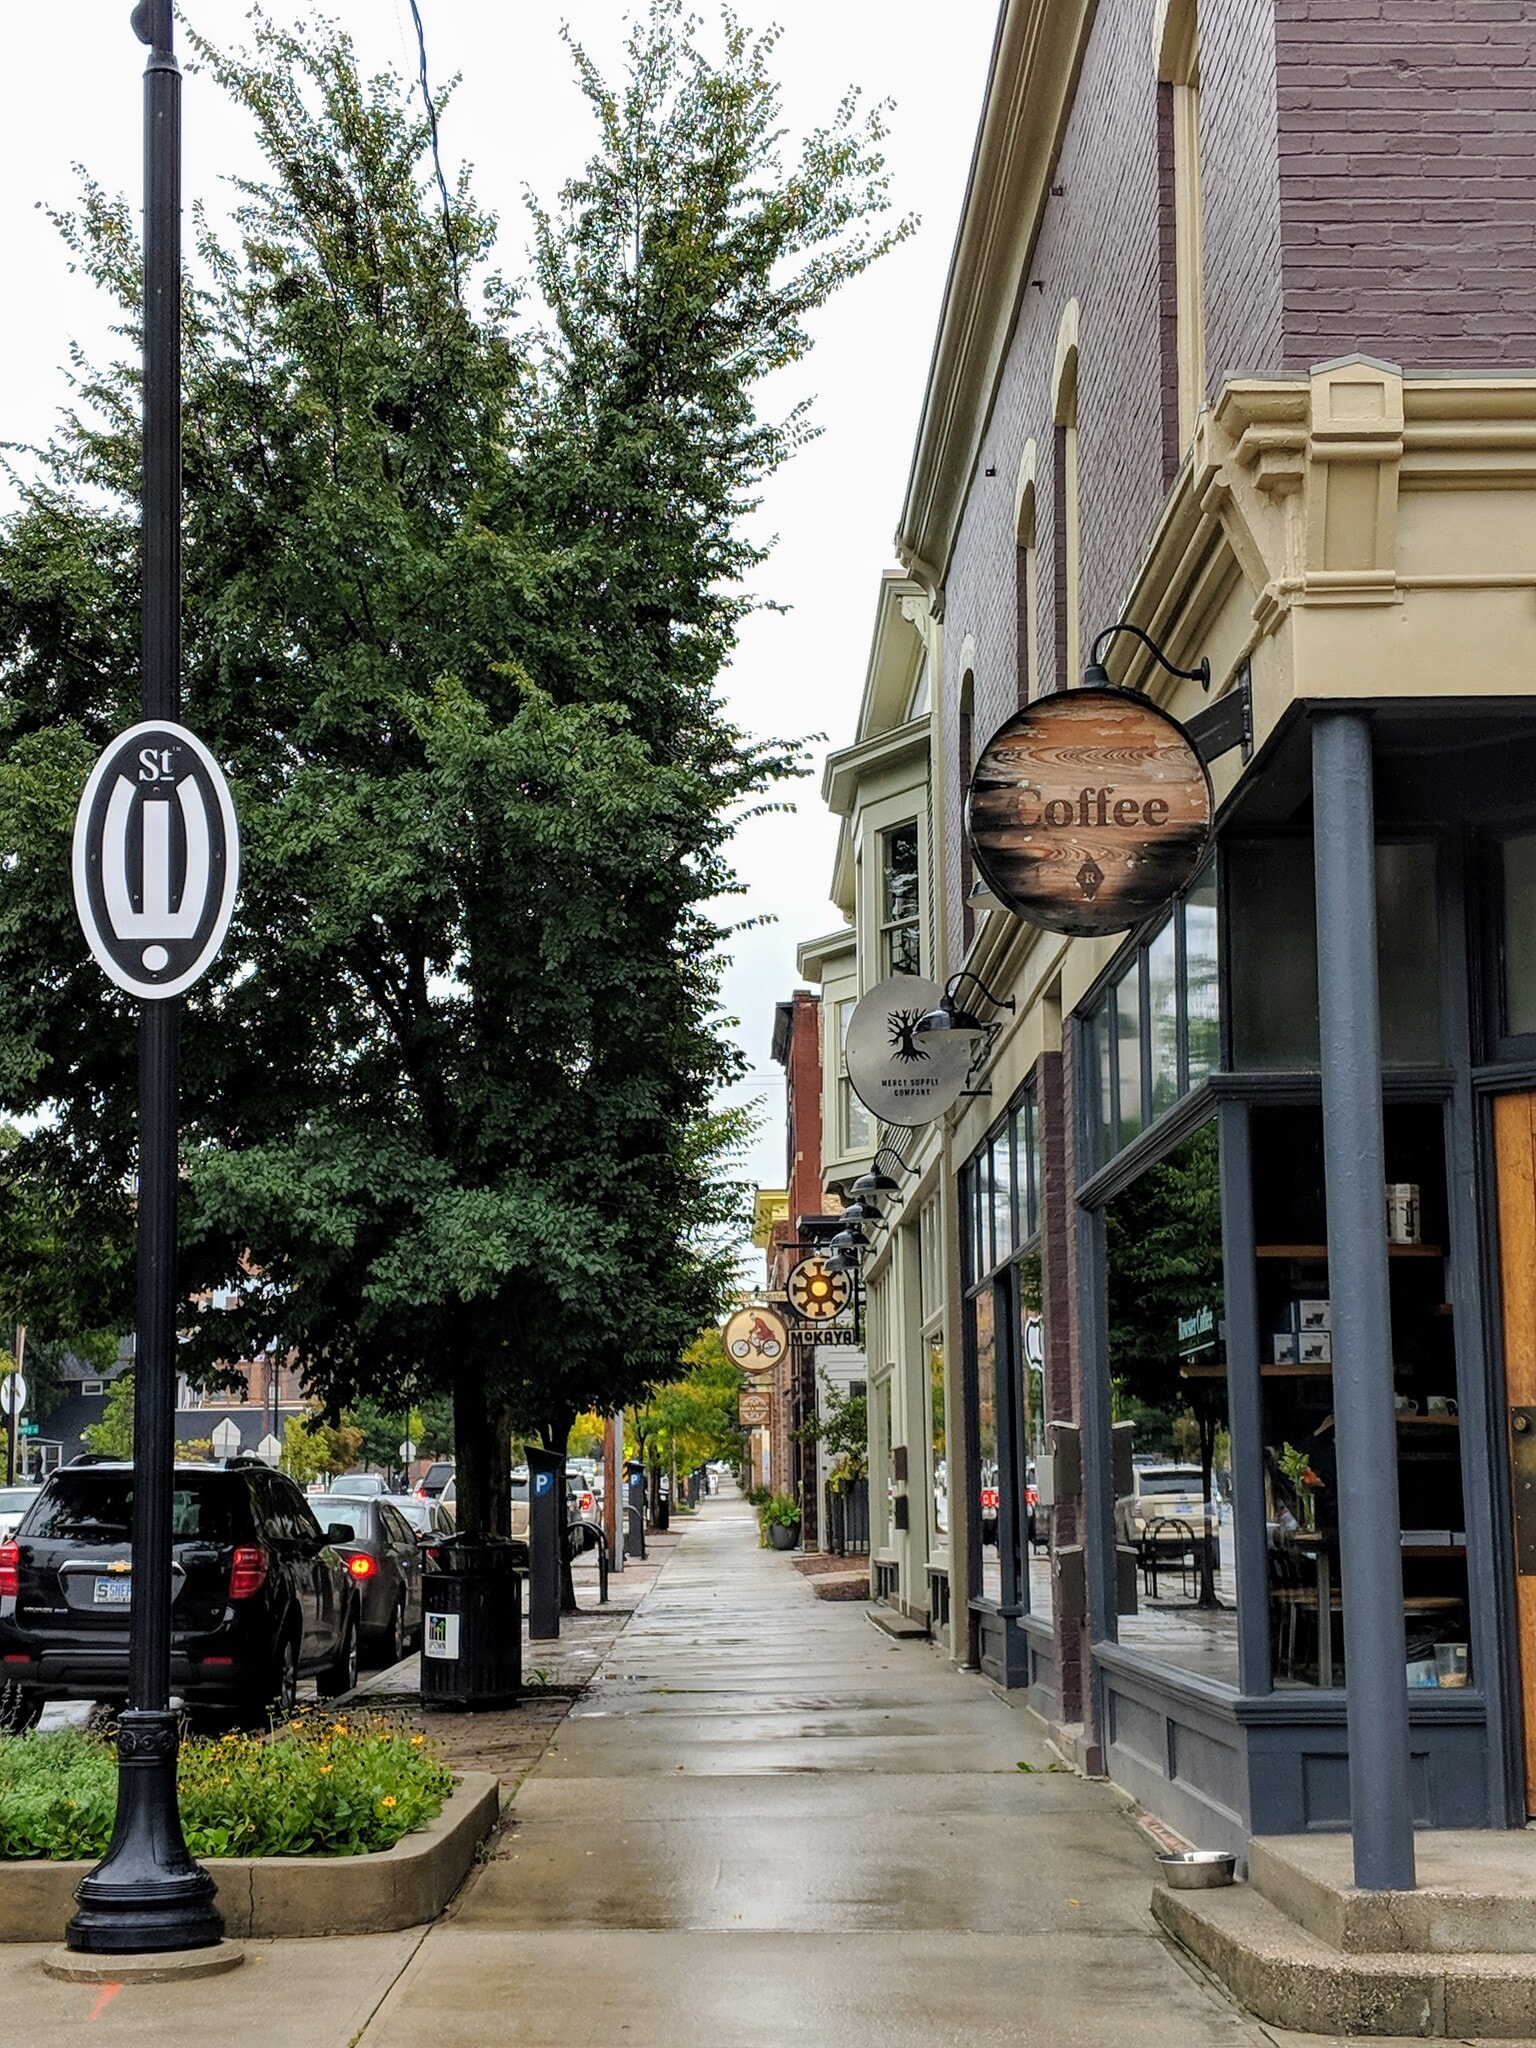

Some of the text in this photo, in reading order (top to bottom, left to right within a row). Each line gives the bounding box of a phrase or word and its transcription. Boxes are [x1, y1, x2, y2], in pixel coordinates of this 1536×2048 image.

[1012, 786, 1170, 828] Coffee
[1083, 871, 1096, 884] R
[881, 1078, 939, 1087] MERCY SUPPLY
[893, 1088, 931, 1097] COMPANY
[535, 1474, 548, 1493] P
[630, 1475, 638, 1486] P
